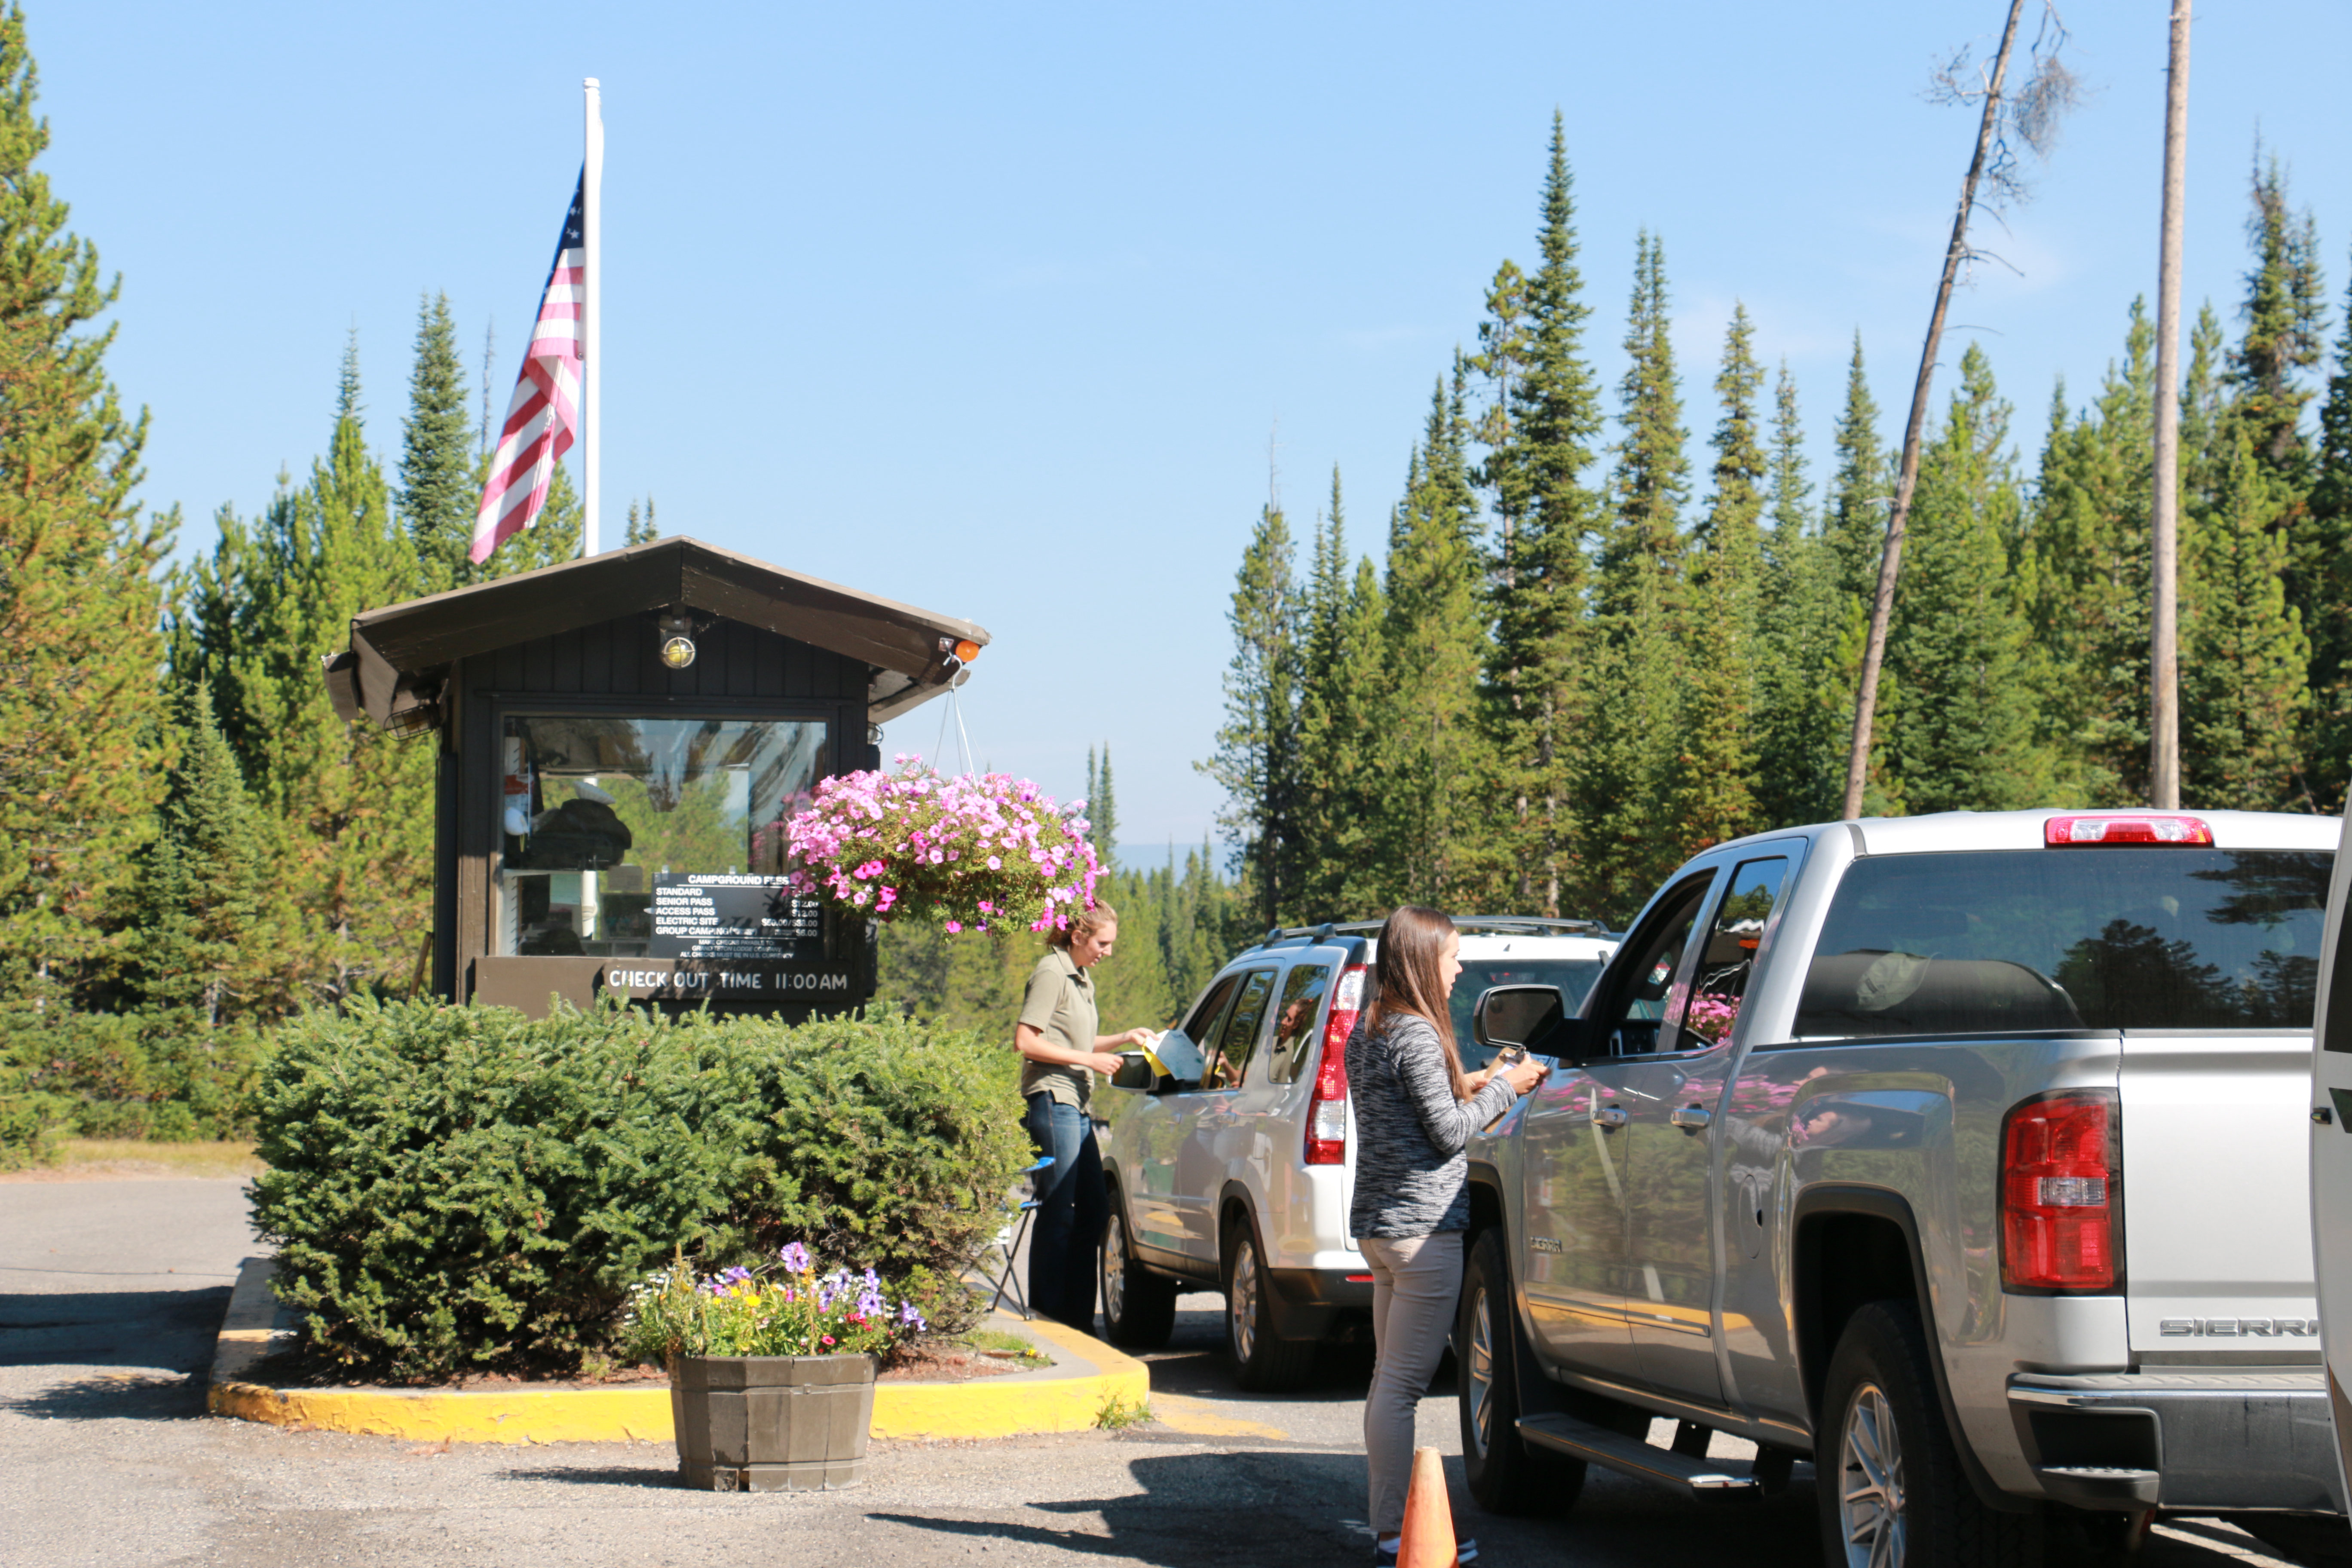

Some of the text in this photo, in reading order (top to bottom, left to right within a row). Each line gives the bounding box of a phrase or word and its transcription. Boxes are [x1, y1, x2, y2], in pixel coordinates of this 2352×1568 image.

[688, 875, 790, 885] CAMPGROUND FEES
[656, 888, 702, 896] STANDARD
[656, 897, 819, 908] SENIOR PASS $12.00
[692, 907, 715, 916] PASS
[792, 909, 818, 917] $12.00
[689, 927, 729, 935] CAMPING
[609, 970, 666, 987] CHECK
[674, 972, 708, 988] OUT
[719, 972, 762, 988] TIME
[2160, 1318, 2319, 1336] SIERR
